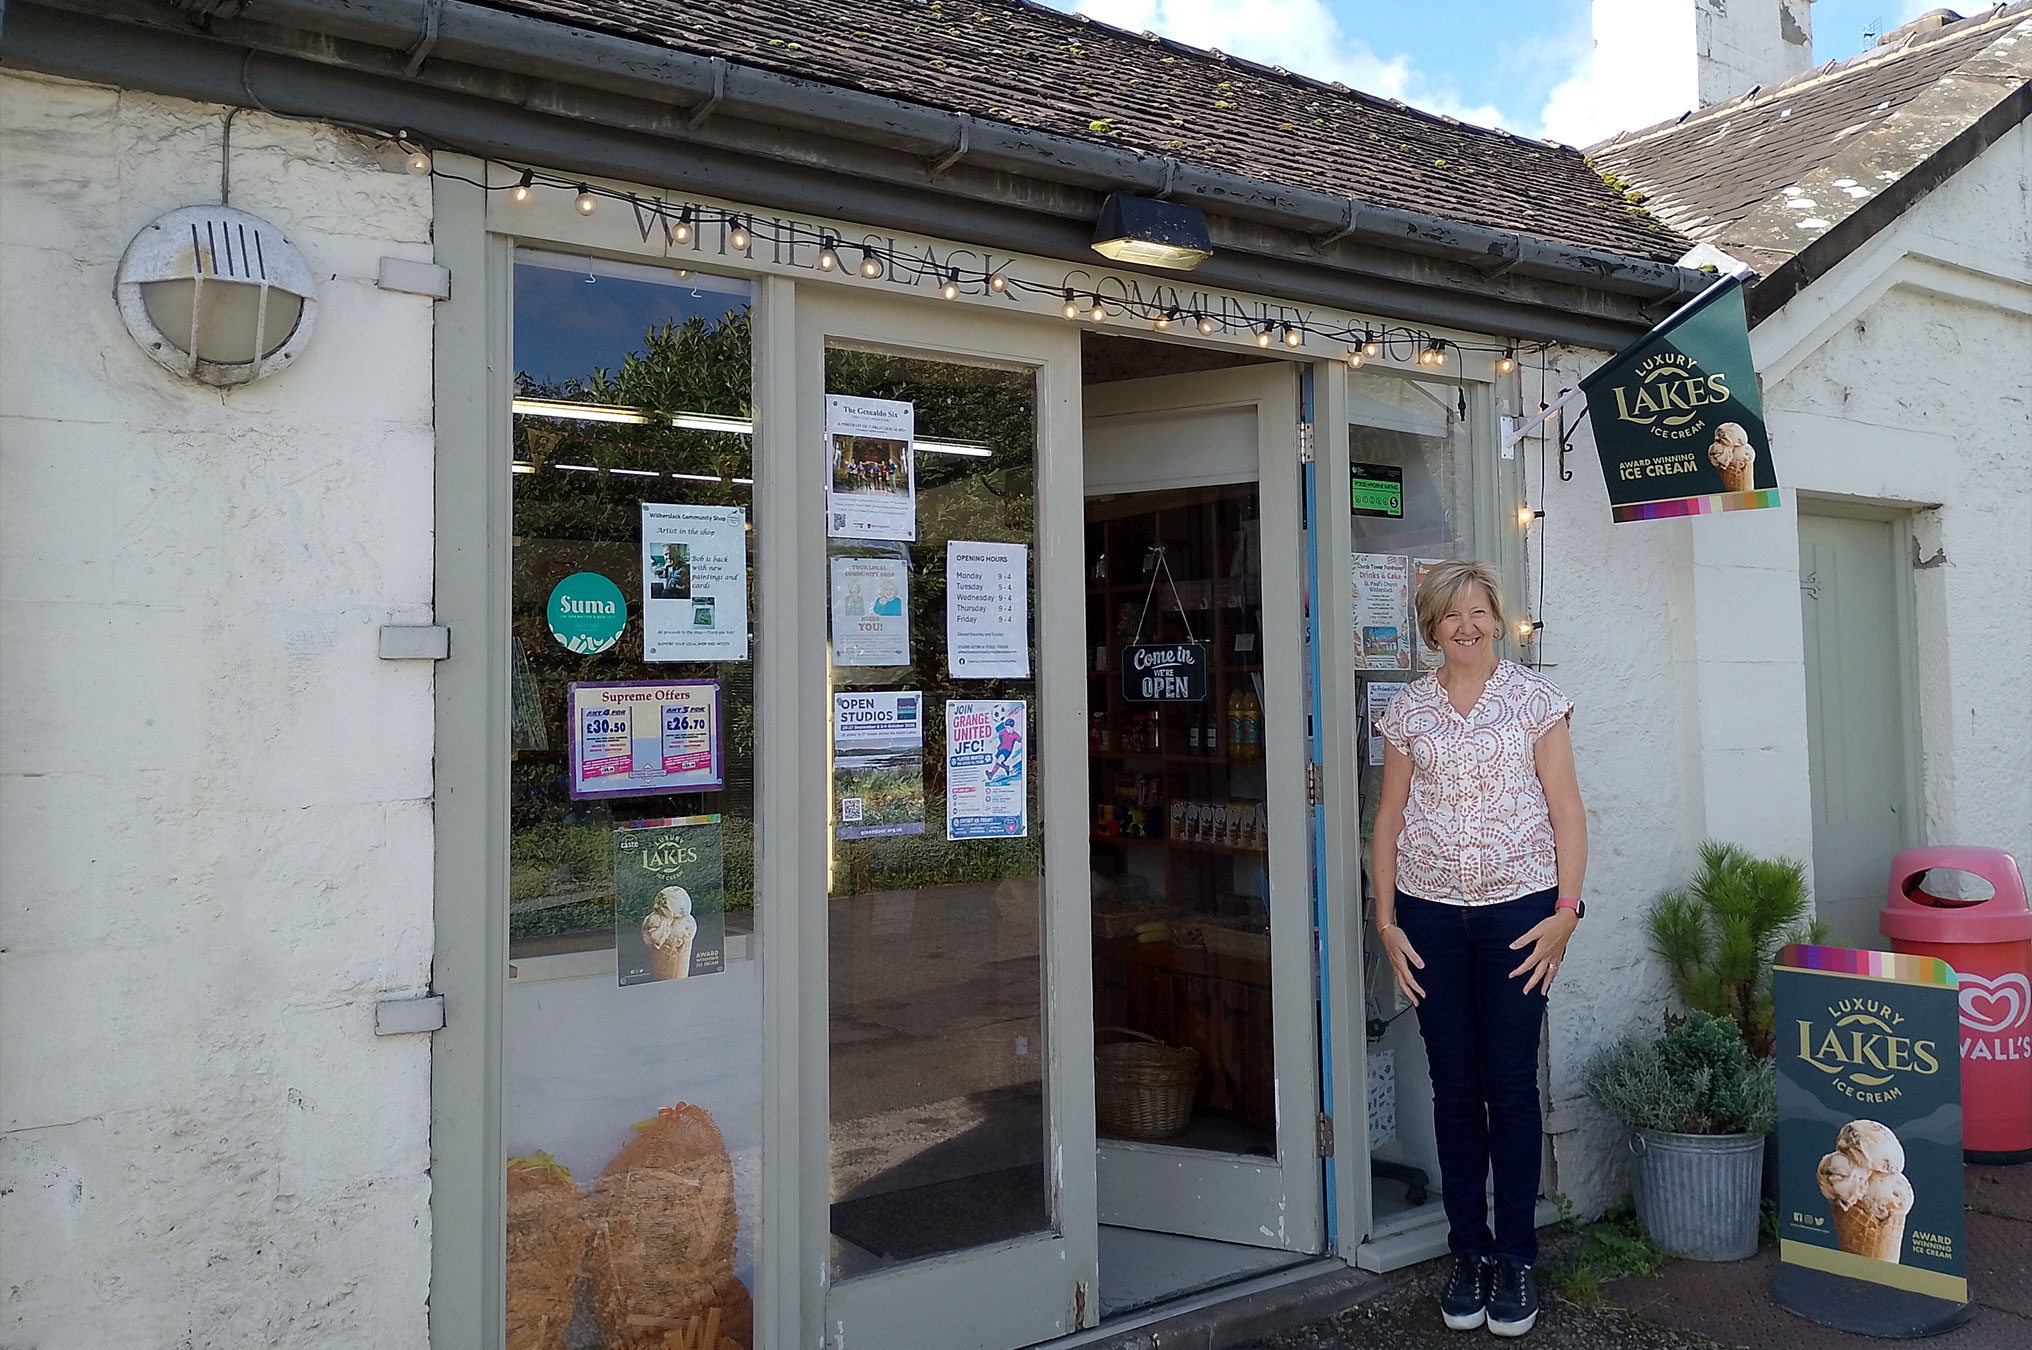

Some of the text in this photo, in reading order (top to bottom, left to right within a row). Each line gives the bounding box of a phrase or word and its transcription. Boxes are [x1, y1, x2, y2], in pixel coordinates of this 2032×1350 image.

[629, 191, 1431, 366] WITHERSLACK COMMUNITY SHOP
[1634, 353, 1698, 377] LUXURY
[1612, 373, 1730, 424] LAKES
[843, 406, 898, 418] The Gesualdo Six
[1650, 420, 1706, 439] ICE CREAM
[1619, 453, 1695, 469] AWARD WINNING
[1619, 460, 1698, 480] ICE CREAM
[1392, 498, 1397, 507] 5
[682, 514, 712, 522] Community
[700, 528, 716, 537] shop
[956, 554, 985, 562] OPENING
[692, 574, 722, 582] paintings
[956, 572, 982, 580] Monday
[1360, 571, 1380, 580] Drinks
[1387, 572, 1402, 580] Cake
[956, 582, 984, 591] Tuesday
[560, 594, 616, 614] Suma
[956, 594, 995, 602] Wednesday
[956, 604, 986, 613] Thursday
[956, 616, 978, 624] Friday
[858, 623, 883, 631] YOU!
[1134, 646, 1195, 670] Come in
[1142, 676, 1188, 698] OPEN
[602, 690, 690, 704] Supreme Offers
[842, 698, 874, 709] OPEN
[602, 708, 610, 716] 4
[954, 704, 974, 715] JOIN
[666, 716, 705, 730] £26.70
[840, 711, 893, 722] STUDIOS
[954, 712, 990, 728] GRANGE
[586, 719, 626, 734] £30.50
[954, 725, 992, 742] UNITED
[955, 740, 984, 754] JFC!
[860, 827, 902, 836] greendoor.org.uk
[620, 841, 638, 849] taste
[654, 834, 684, 846] LUXURY
[642, 847, 698, 872] LAKES
[655, 870, 684, 881] ICE CREAM
[696, 950, 719, 958] AWARD
[1828, 998, 1904, 1026] LUXURY
[1796, 1019, 1939, 1075] LAKES
[1832, 1077, 1902, 1103] ICE CREAM
[1912, 1230, 1952, 1246] AWARD
[1912, 1238, 1952, 1253] WINNING
[1912, 1246, 1952, 1260] ICE CREAM
